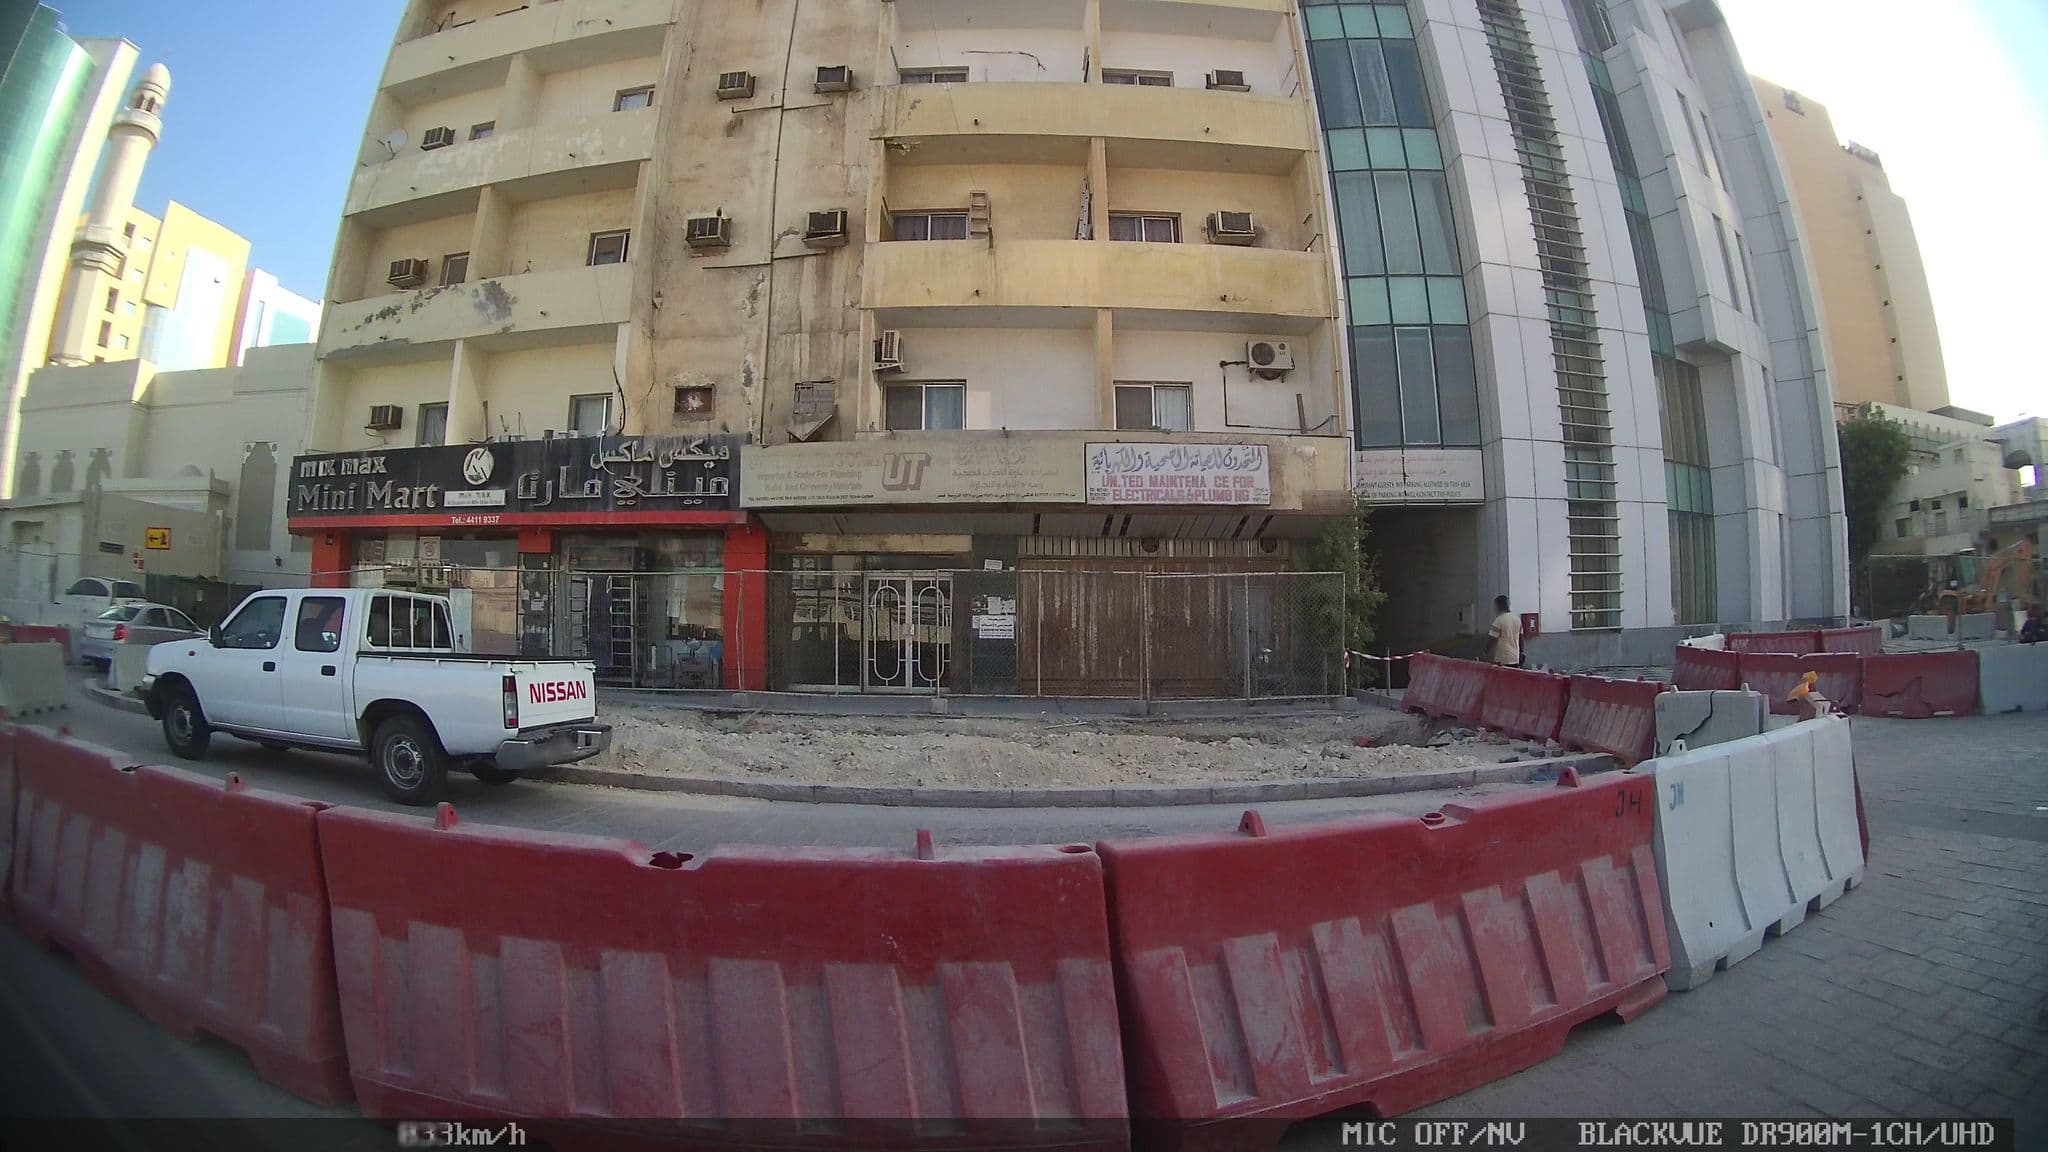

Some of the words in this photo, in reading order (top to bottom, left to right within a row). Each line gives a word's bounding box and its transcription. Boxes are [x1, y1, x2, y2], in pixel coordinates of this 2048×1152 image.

[340, 456, 388, 476] max
[1232, 475, 1255, 488] FOR
[297, 483, 357, 511] Mini
[365, 480, 440, 509] Mart
[466, 515, 482, 524] 4411
[483, 515, 500, 524] 9337
[529, 680, 586, 704] NISSAN
